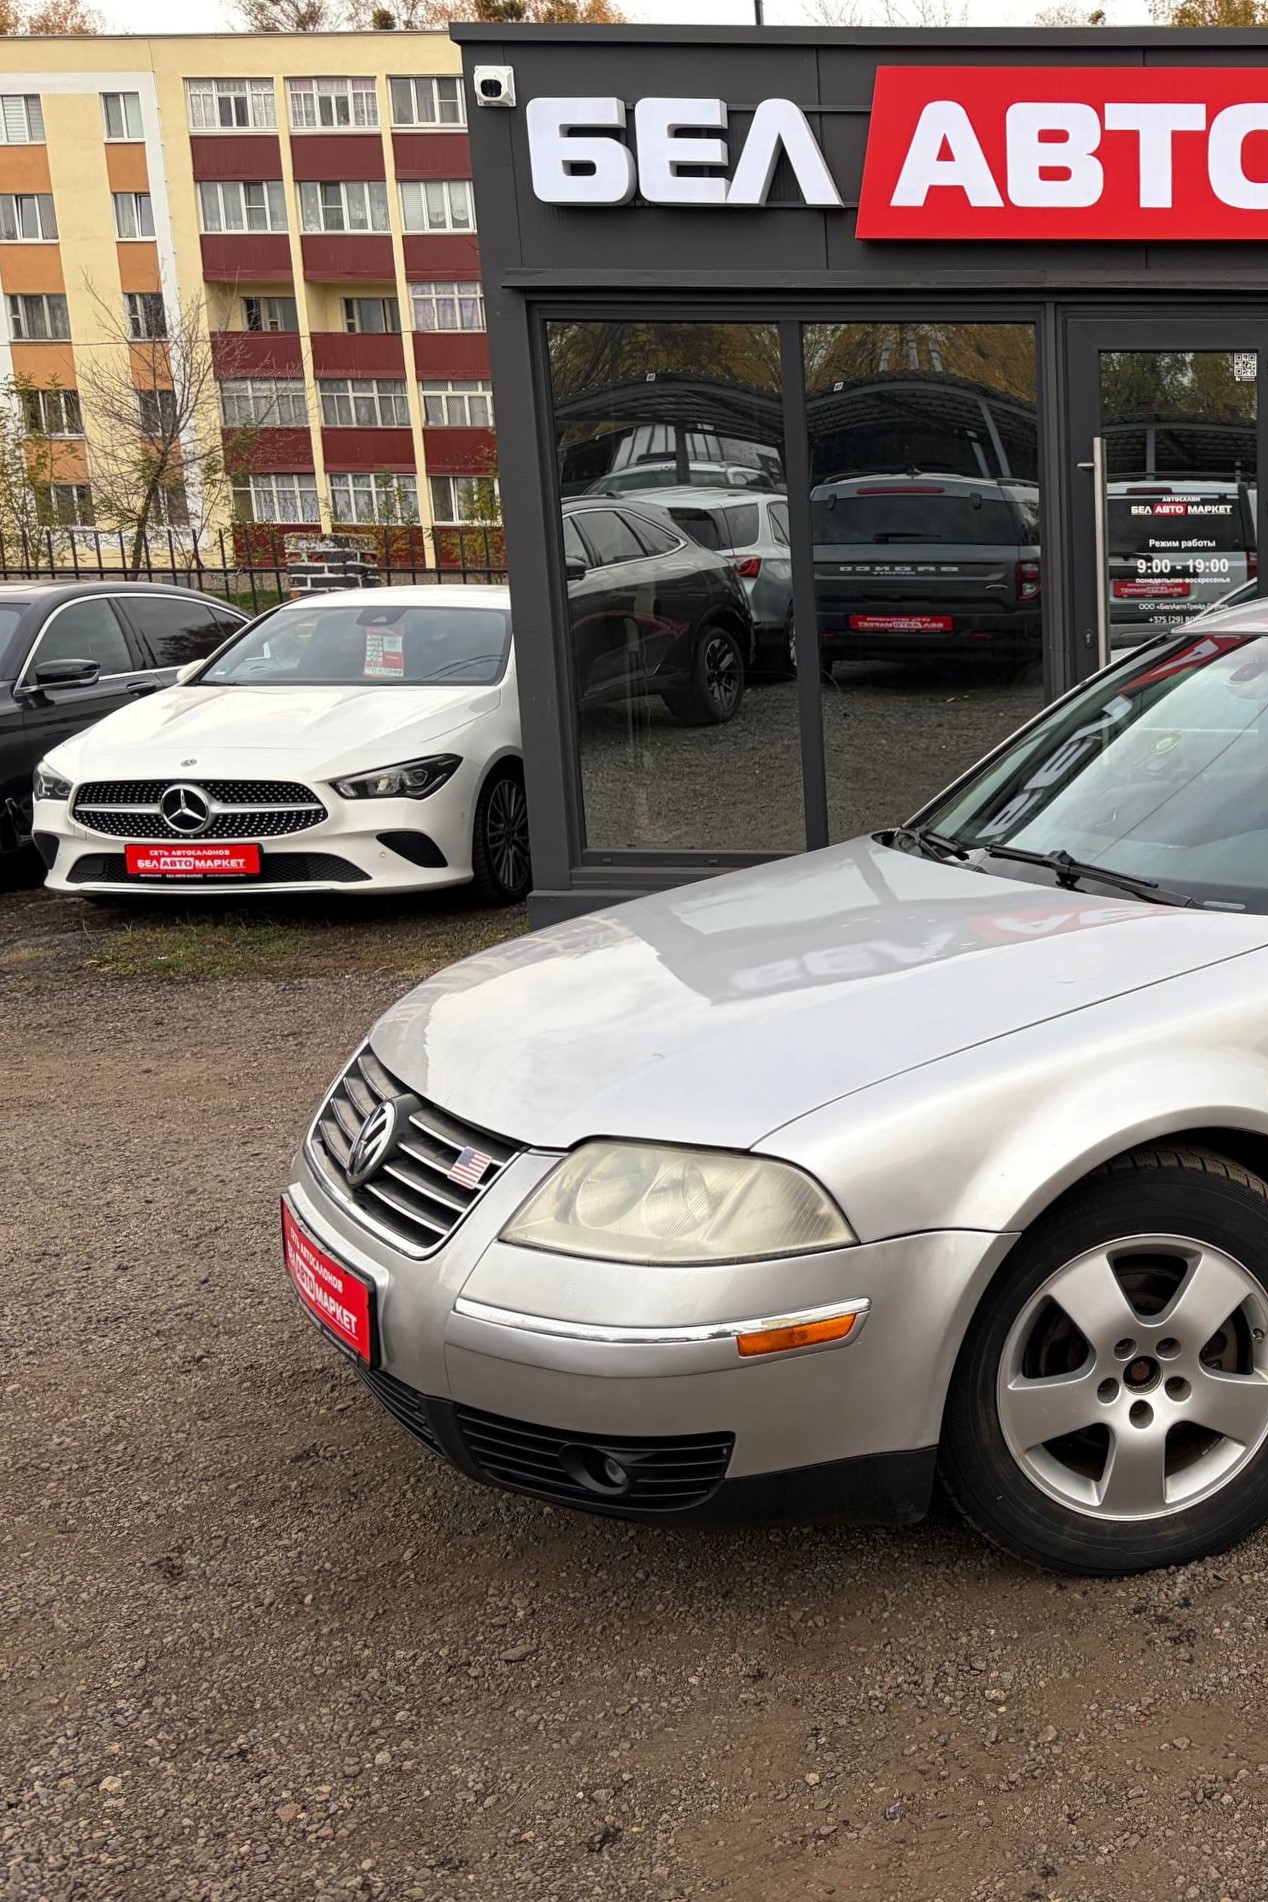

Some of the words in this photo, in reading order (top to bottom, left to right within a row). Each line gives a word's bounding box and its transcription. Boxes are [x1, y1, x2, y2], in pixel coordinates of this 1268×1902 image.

[526, 97, 845, 207] БЕЛ
[1131, 505, 1152, 514] БЕЛ
[1155, 505, 1184, 513] АВТО
[1187, 505, 1233, 514] МАРКЕТ
[1149, 539, 1179, 547] Режим
[1181, 538, 1216, 549] работы
[1137, 559, 1171, 573] 9:00
[1187, 559, 1229, 573] 19:00
[1149, 616, 1168, 624] +375
[1168, 616, 1184, 624] (29)
[137, 859, 159, 867] БЕЛ
[162, 859, 193, 868] АВТО
[195, 859, 245, 867] МАРКЕТ
[301, 1242, 343, 1293] АВТОСАЛОНОВ
[315, 1282, 357, 1334] МАРКЕТ
